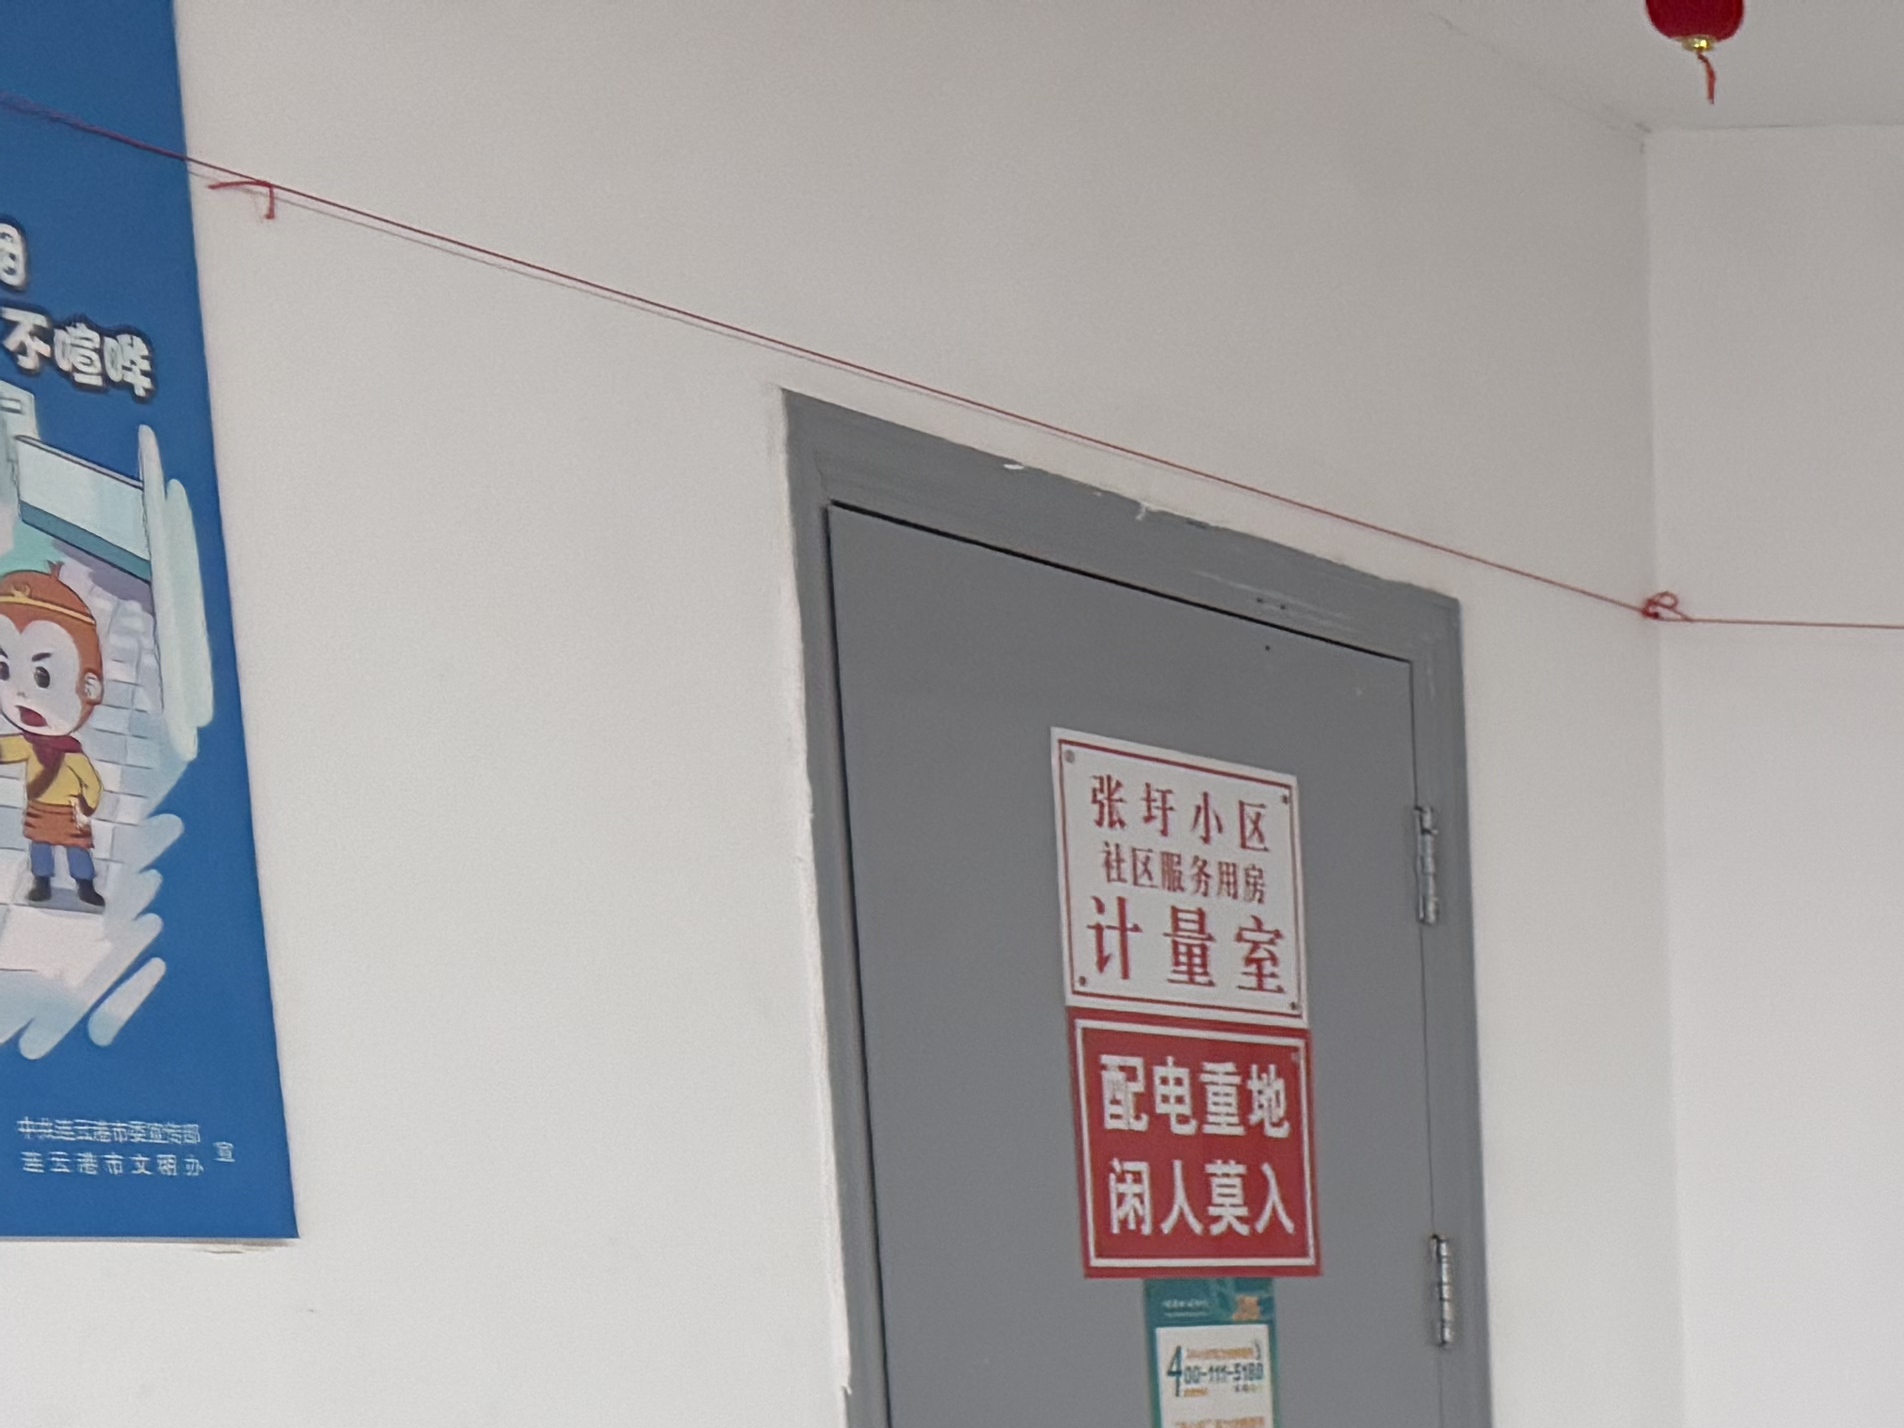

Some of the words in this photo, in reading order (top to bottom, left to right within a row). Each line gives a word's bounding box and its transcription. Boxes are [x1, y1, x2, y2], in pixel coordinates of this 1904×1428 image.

[0, 306, 152, 397] 不喧哗
[1090, 774, 1270, 853] 张圩小区
[1099, 841, 1267, 904] 社区服务用房
[1086, 895, 1285, 995] 计量室
[1099, 1054, 1292, 1138] 配电重地
[1108, 1157, 1295, 1236] 闲人莫入
